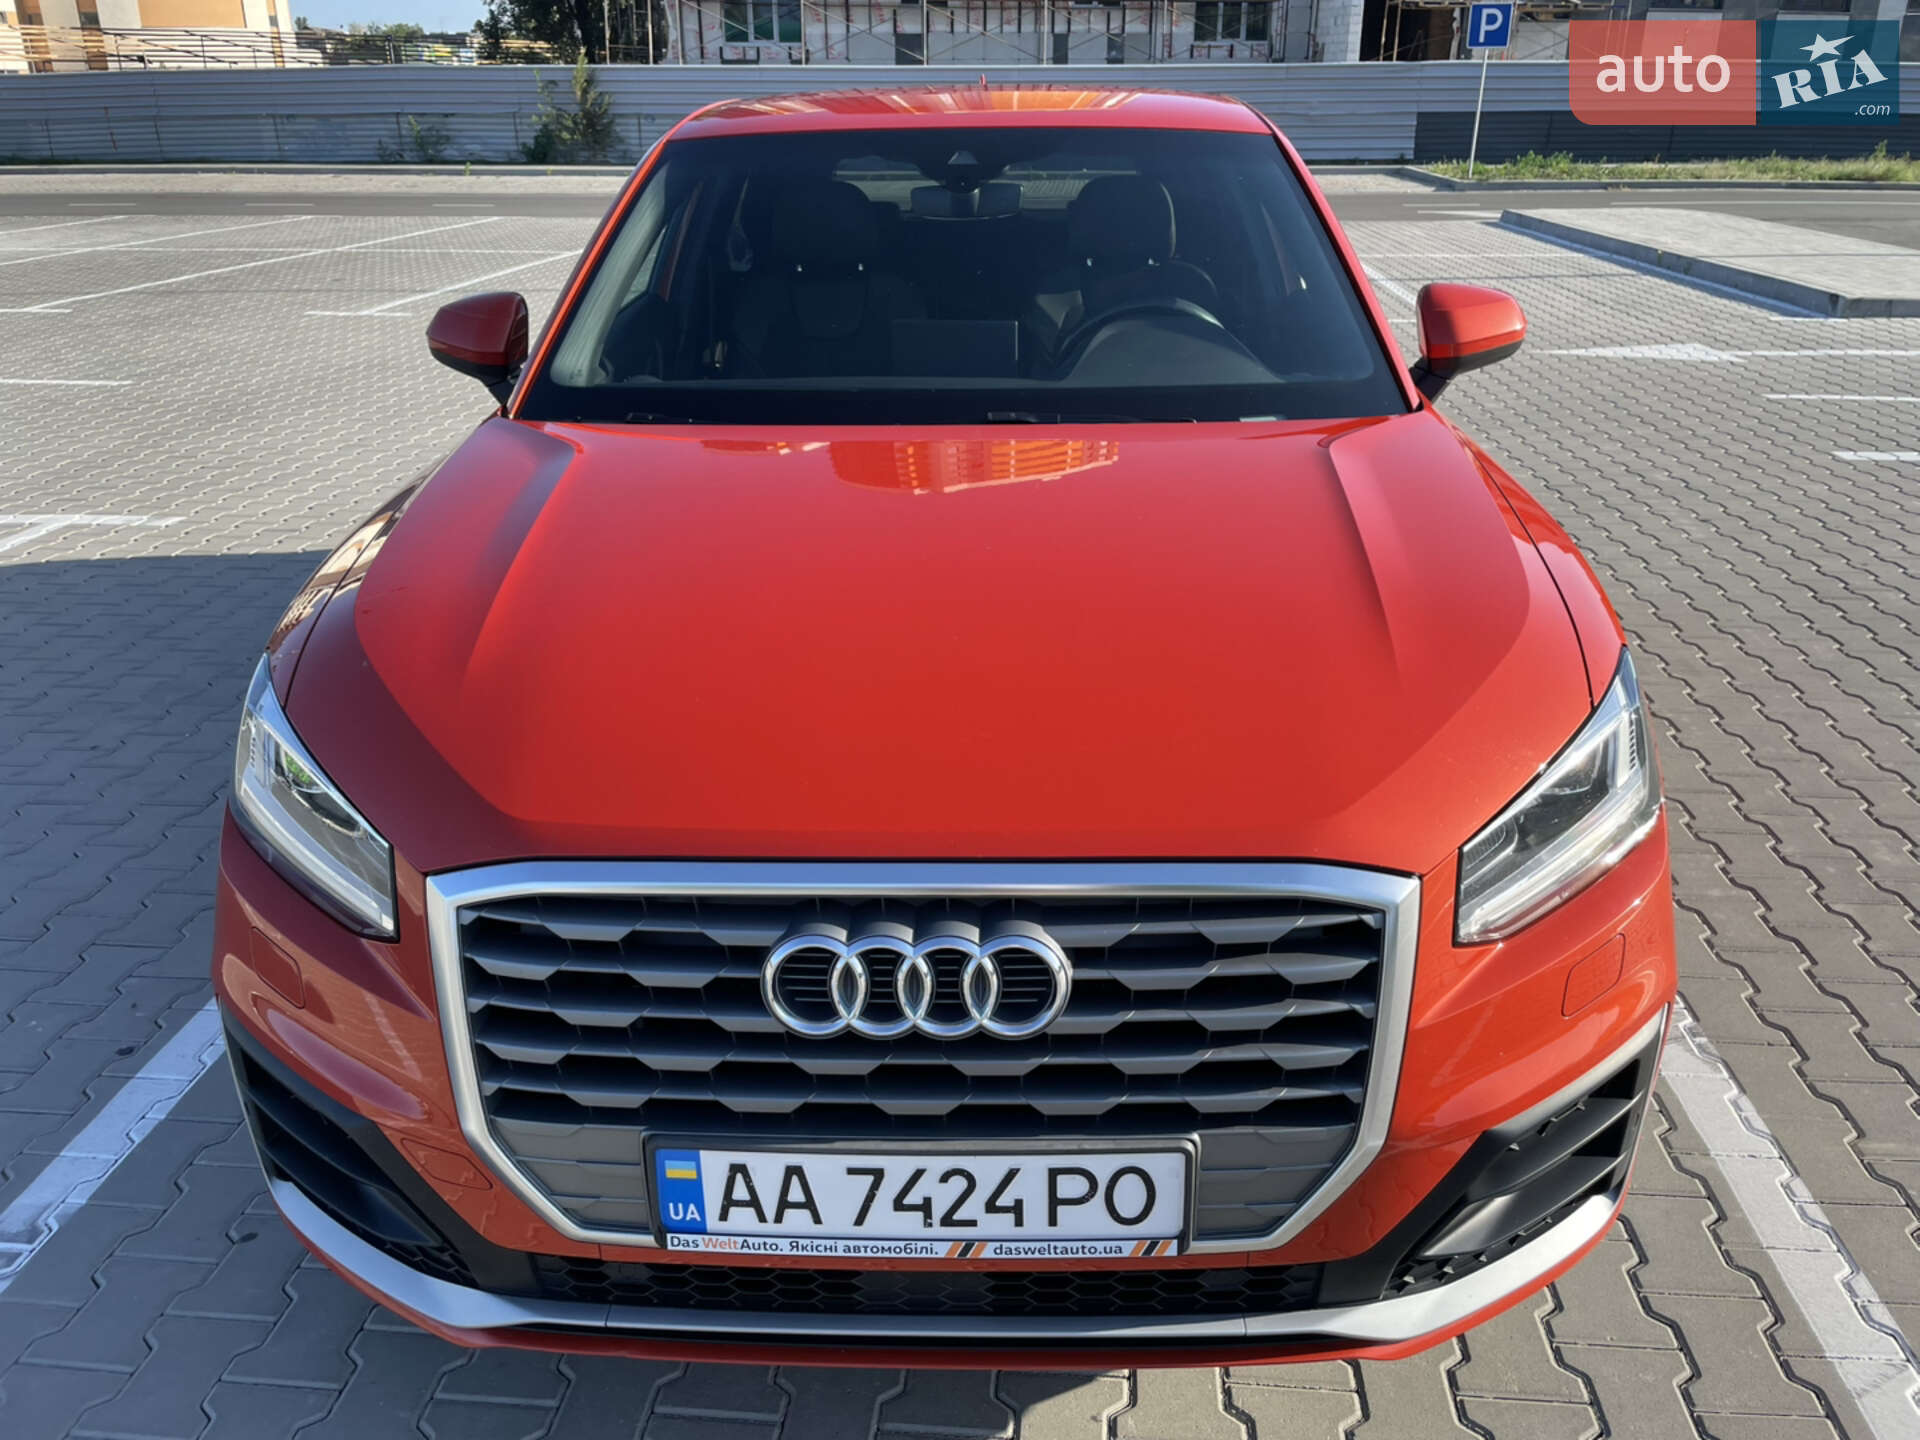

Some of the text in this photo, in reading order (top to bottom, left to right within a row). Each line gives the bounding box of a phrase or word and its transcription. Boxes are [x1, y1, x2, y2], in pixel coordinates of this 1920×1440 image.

[1478, 8, 1502, 43] P
[717, 1162, 1157, 1228] AA 7424 PO
[668, 1202, 701, 1222] UA
[669, 1236, 699, 1249] Das
[788, 1240, 839, 1254] Якісні
[842, 1241, 939, 1256] автомобілі.
[993, 1242, 1123, 1256] dasweltauto.ua
